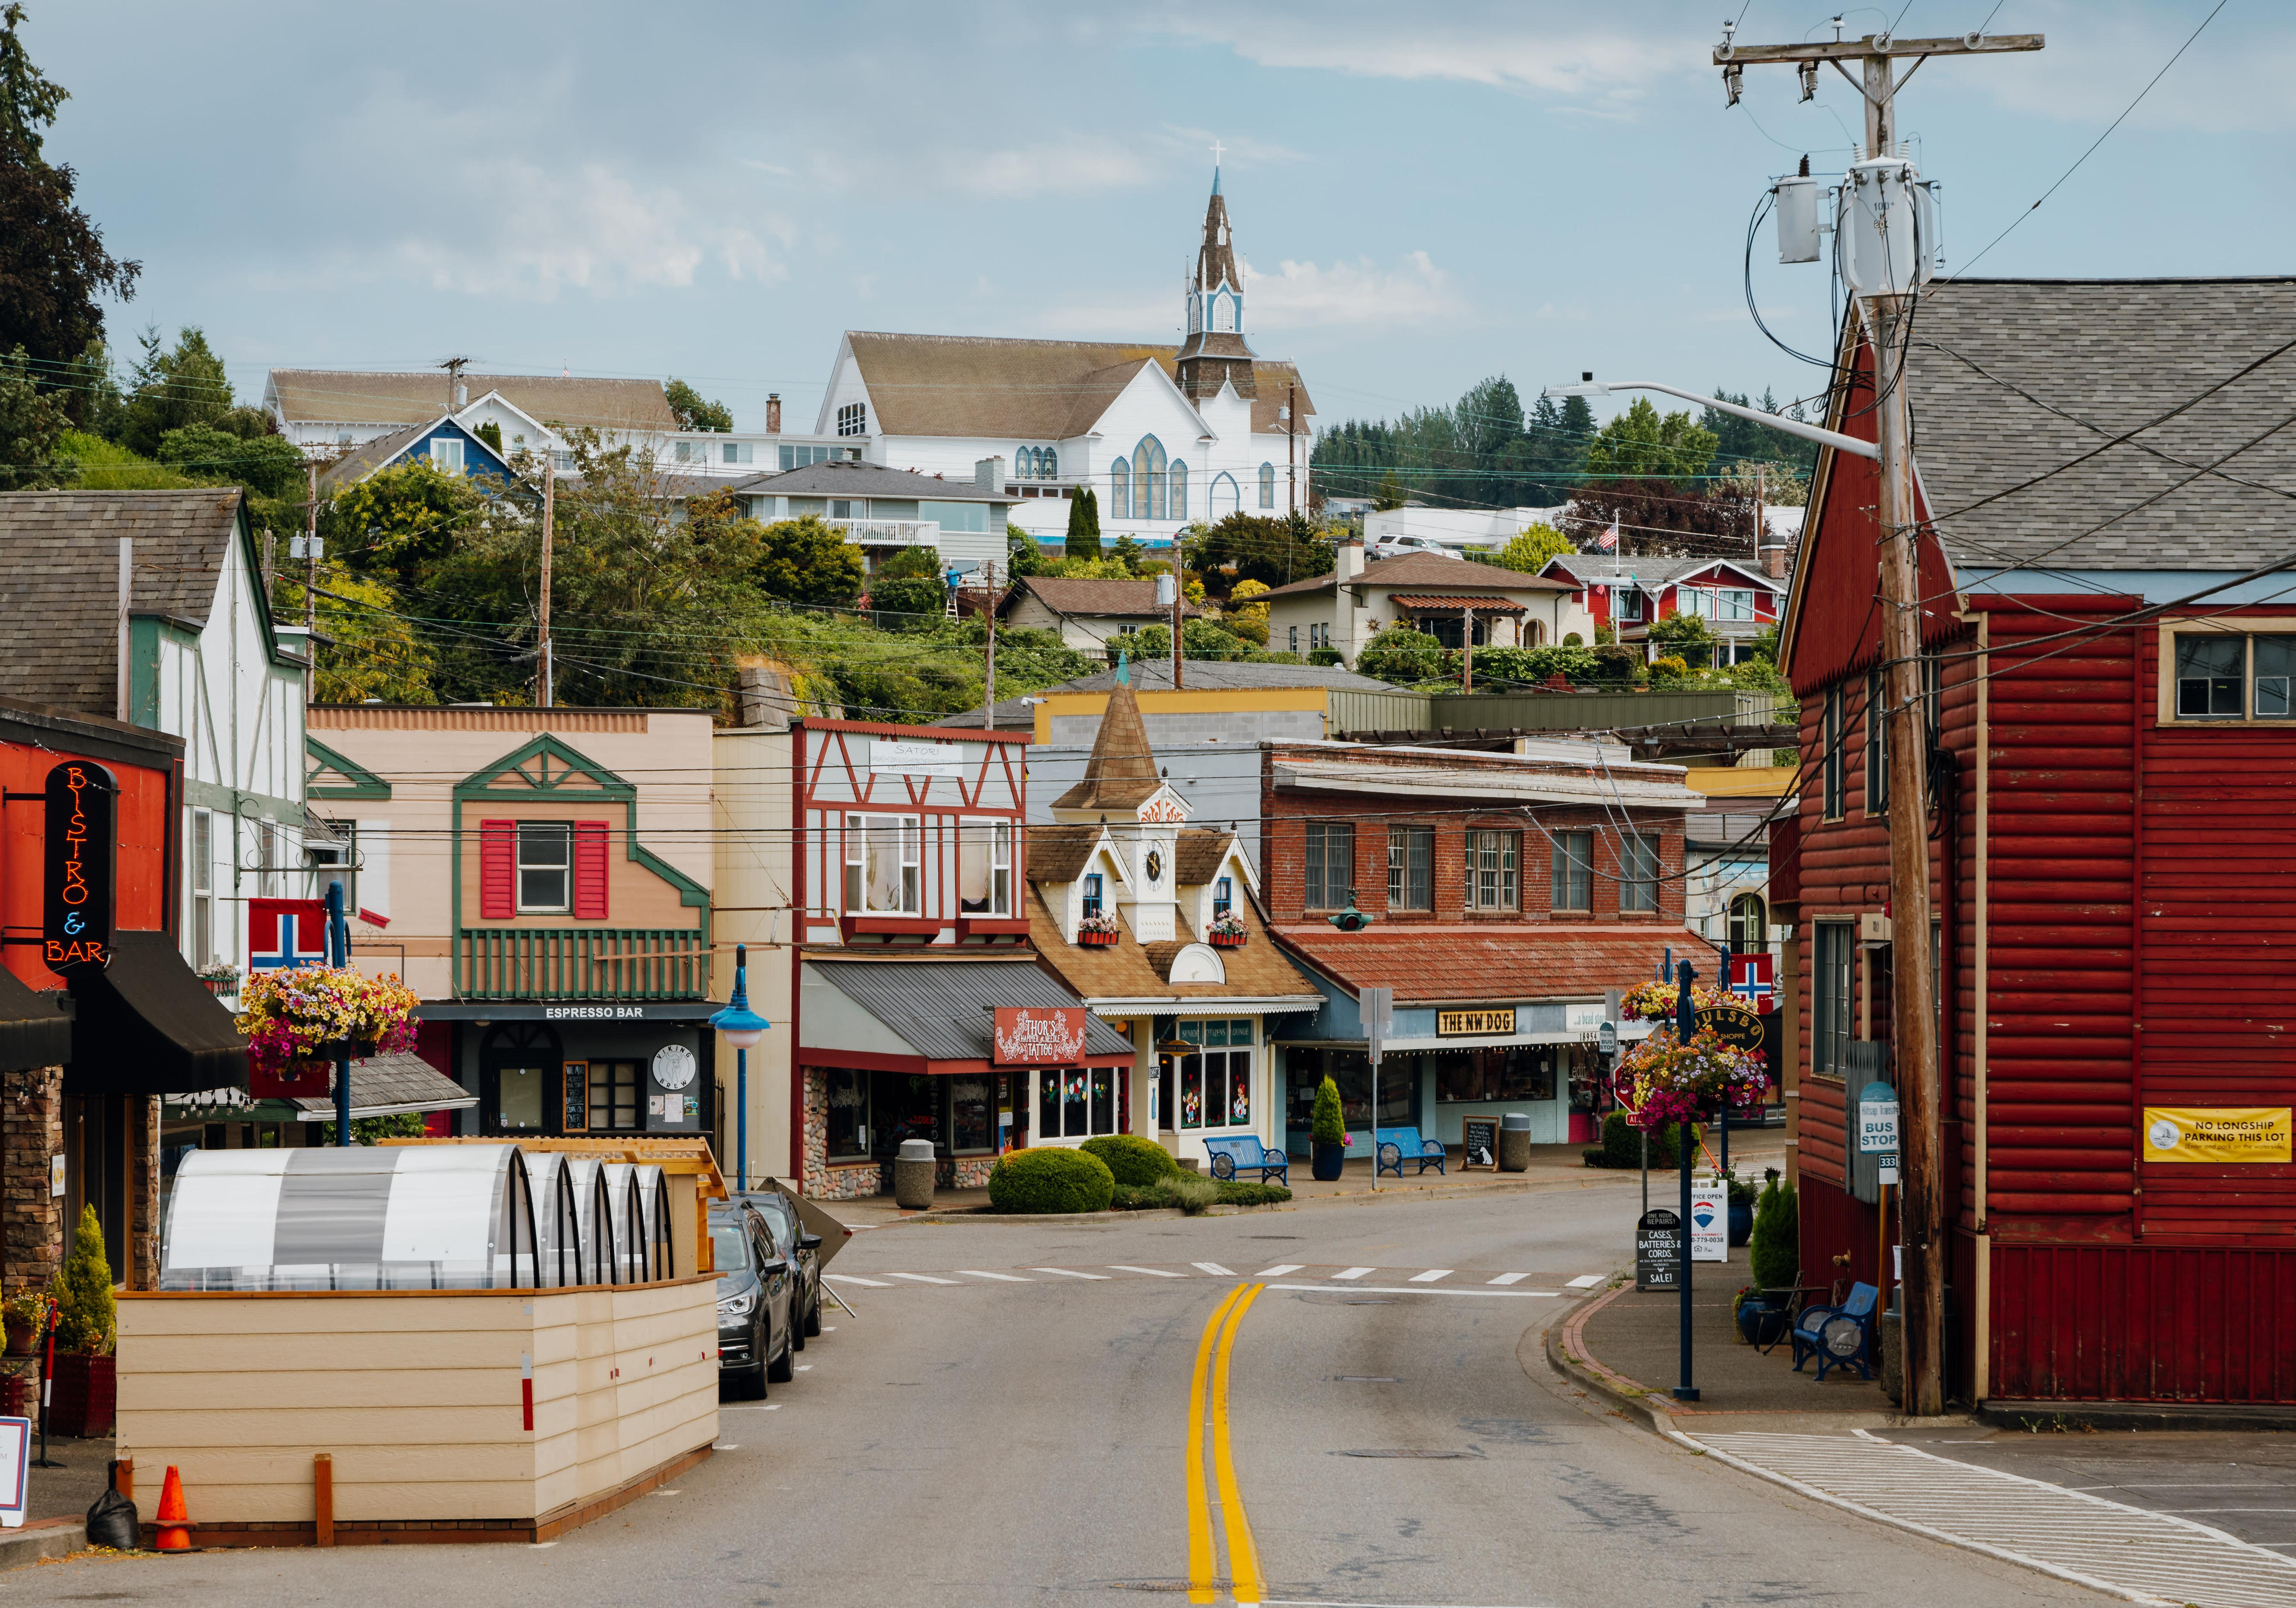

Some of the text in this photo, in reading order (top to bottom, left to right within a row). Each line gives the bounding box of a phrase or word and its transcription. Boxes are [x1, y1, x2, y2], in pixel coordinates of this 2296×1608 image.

[895, 746, 939, 756] SATORI
[888, 765, 945, 773] satoriwellbeing.com
[63, 768, 87, 904] BISTRO
[65, 912, 85, 934] &
[46, 941, 104, 961] BAR
[546, 1008, 643, 1018] ESPRESSO BAR
[1582, 1011, 1594, 1025] bead
[1443, 1013, 1510, 1031] THE NW DOG
[1025, 1020, 1056, 1035] THOR'S
[1580, 1032, 1597, 1041] 18954
[657, 1046, 691, 1059] VIKING
[1028, 1043, 1053, 1061] TATTOO
[1150, 1067, 1160, 1079] 18972
[1572, 1063, 1587, 1078] edit
[659, 1078, 687, 1089] BREW
[1862, 1106, 1877, 1116] Kitsap
[567, 1114, 581, 1123] OVER
[1866, 1122, 1893, 1133] BUS
[1862, 1135, 1897, 1145] STOP
[2185, 1133, 2235, 1142] PARKING
[1881, 1158, 1895, 1167] 333
[1649, 1231, 1672, 1240] CASES,
[1639, 1240, 1675, 1249] BATTERIES
[1648, 1250, 1673, 1258] CORDS.
[1650, 1273, 1673, 1283] SALE!
